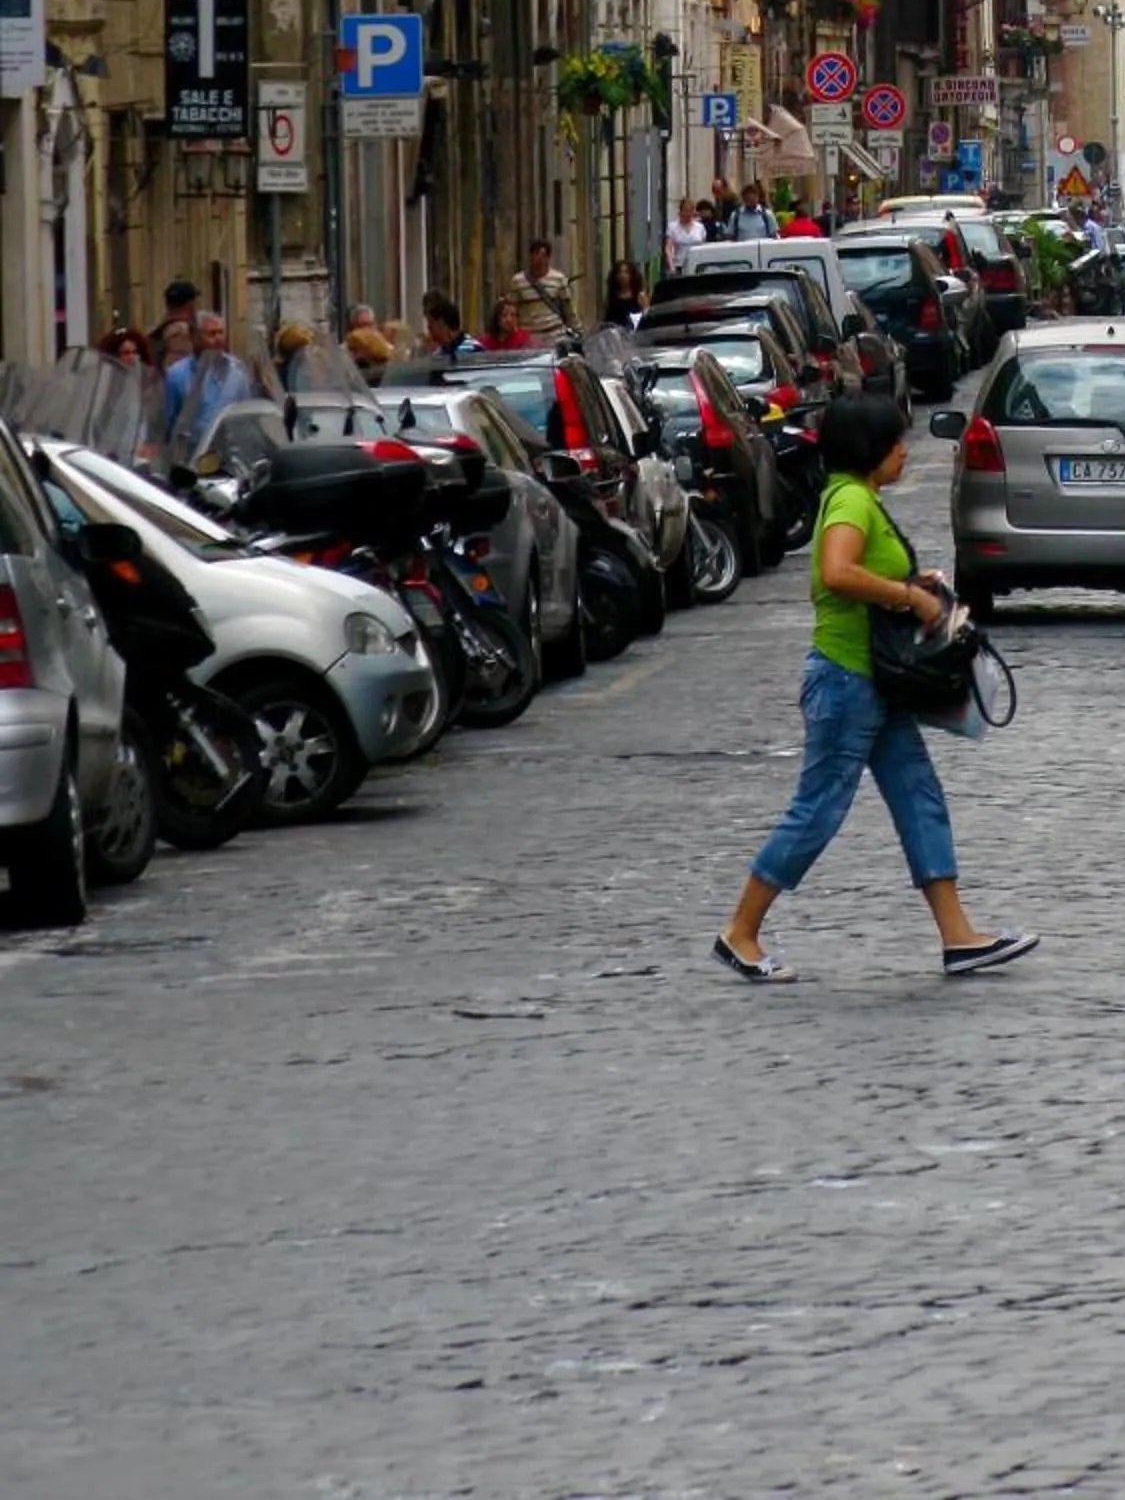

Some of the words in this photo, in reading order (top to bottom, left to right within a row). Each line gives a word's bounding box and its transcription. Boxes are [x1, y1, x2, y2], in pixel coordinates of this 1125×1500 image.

[357, 23, 406, 88] P
[180, 90, 219, 105] SALE
[172, 107, 243, 121] TABACCHI
[709, 98, 729, 124] P
